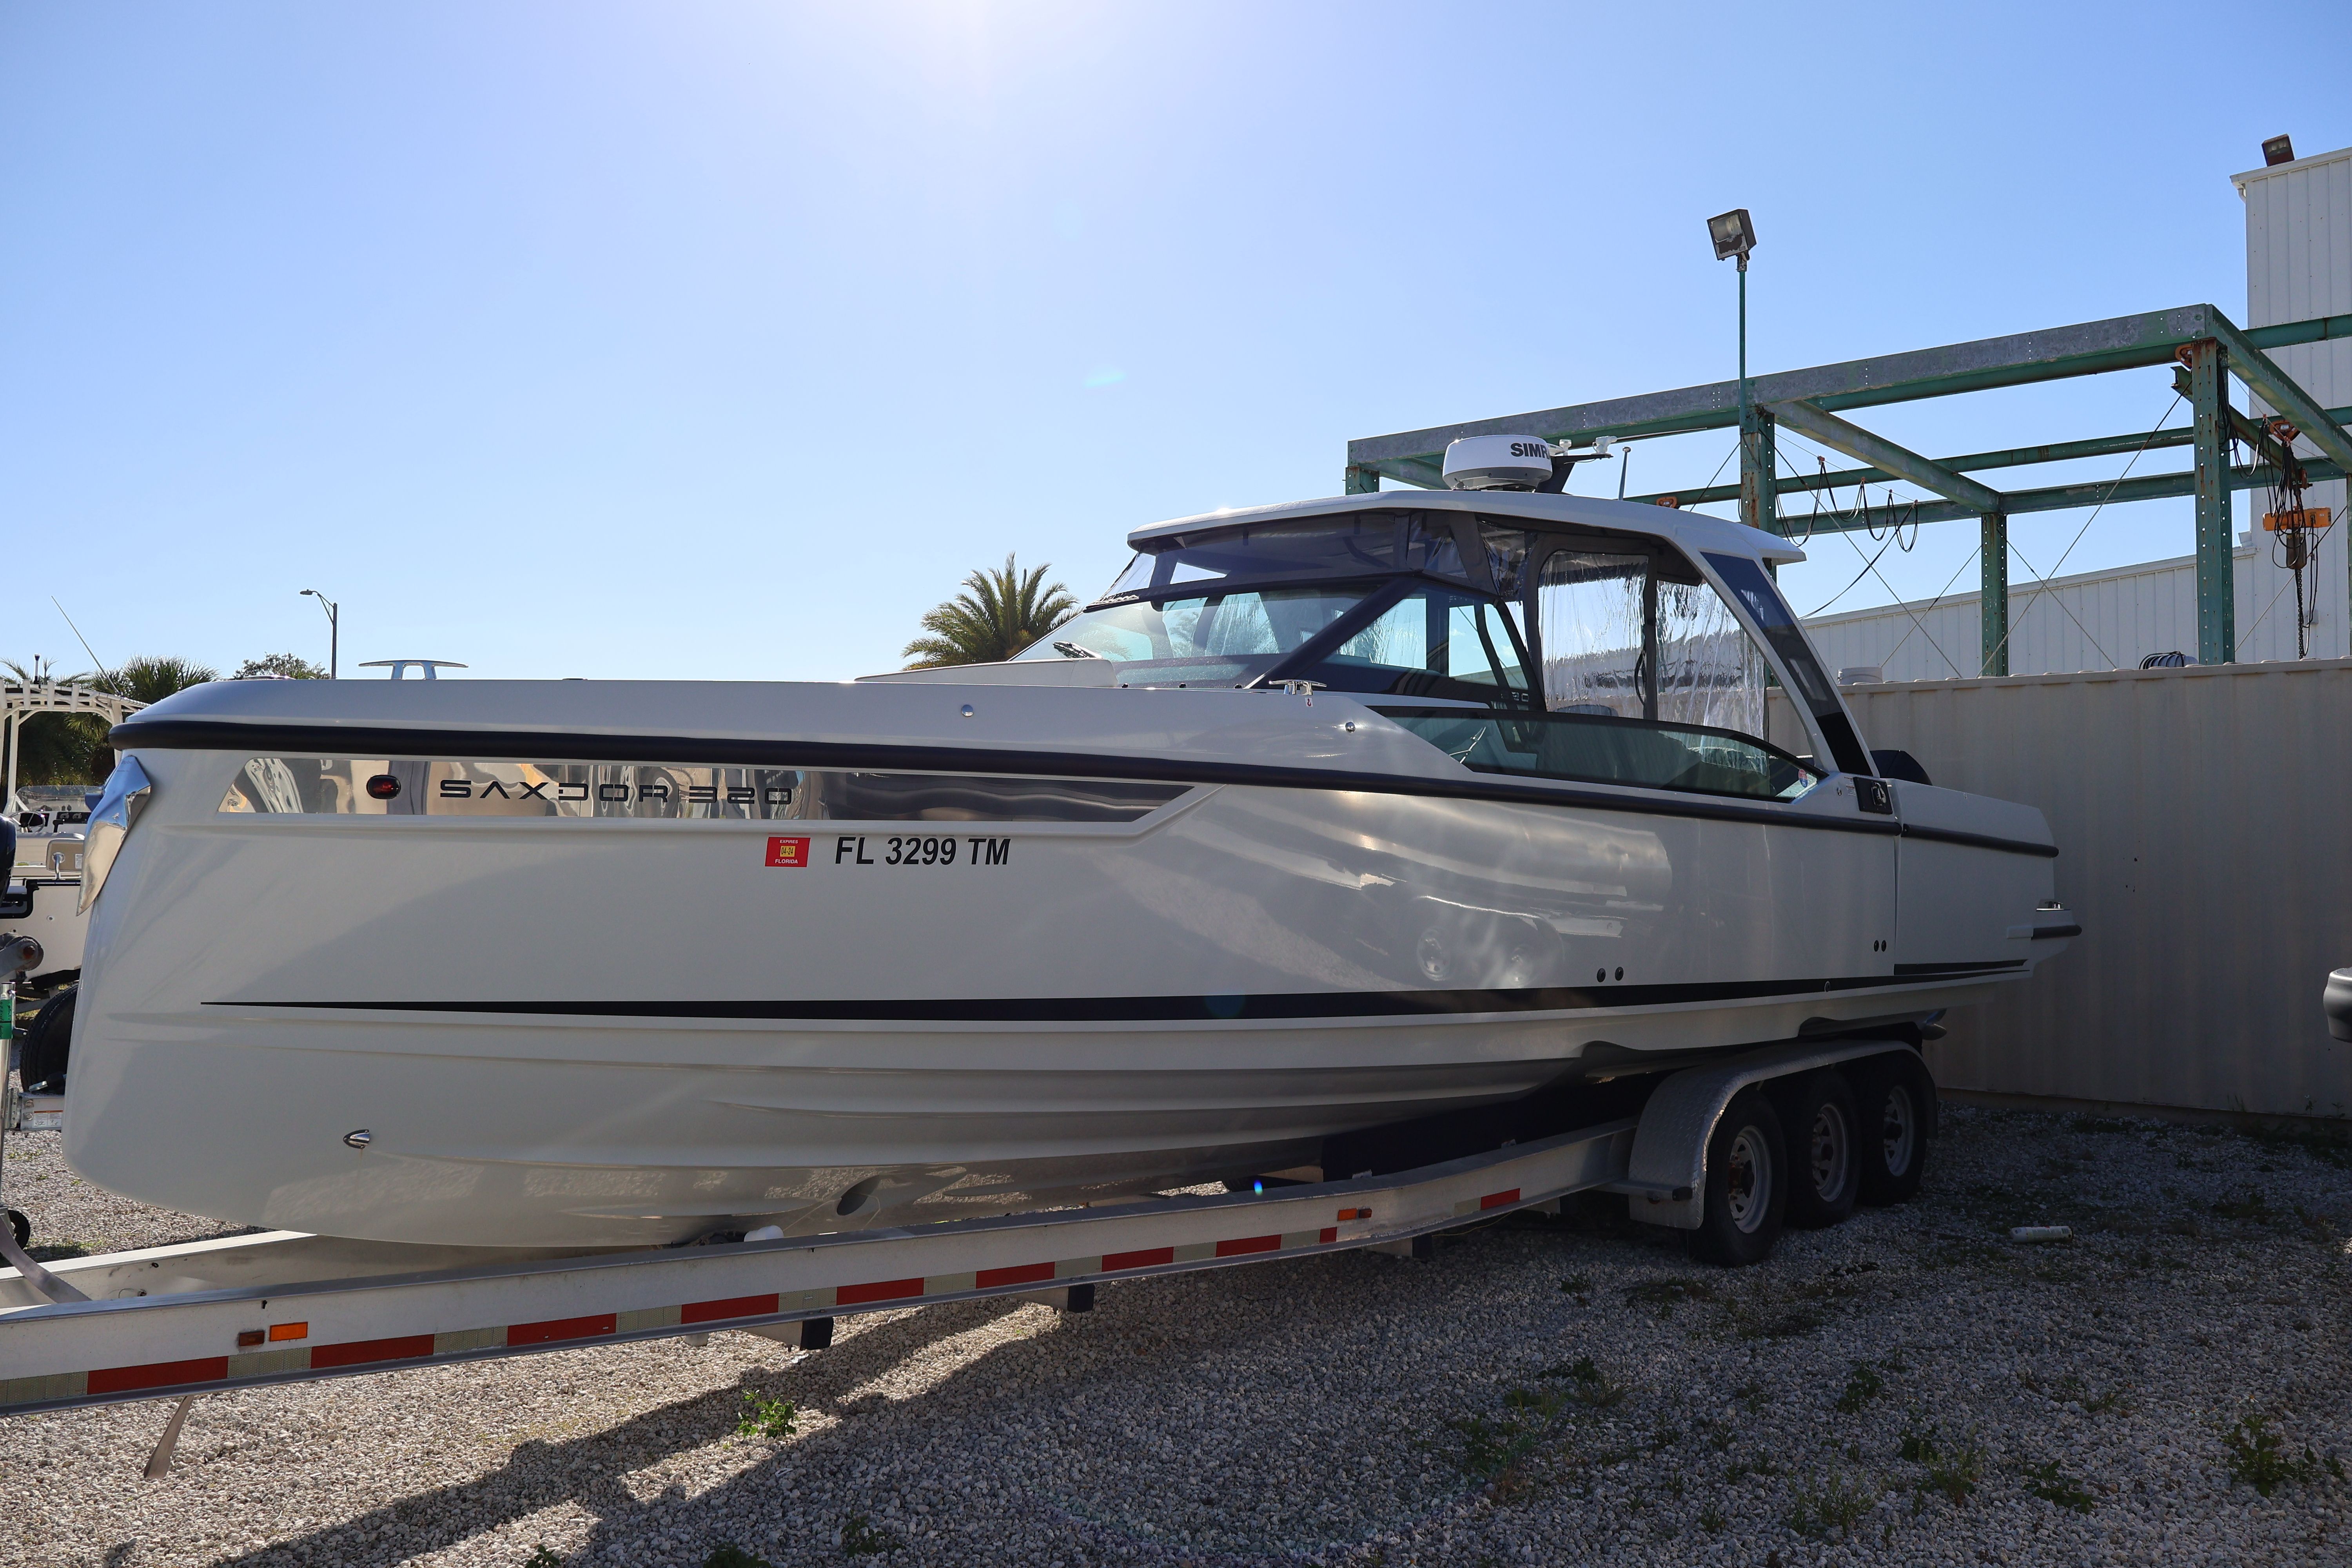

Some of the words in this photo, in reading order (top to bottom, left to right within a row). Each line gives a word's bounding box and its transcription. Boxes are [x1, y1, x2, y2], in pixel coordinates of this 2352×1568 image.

[1510, 443, 1550, 460] SIMR
[440, 780, 668, 803] SAXDOR
[689, 786, 792, 805] 320
[835, 837, 874, 864] FL
[886, 837, 956, 865] 3299
[967, 838, 1011, 865] TM
